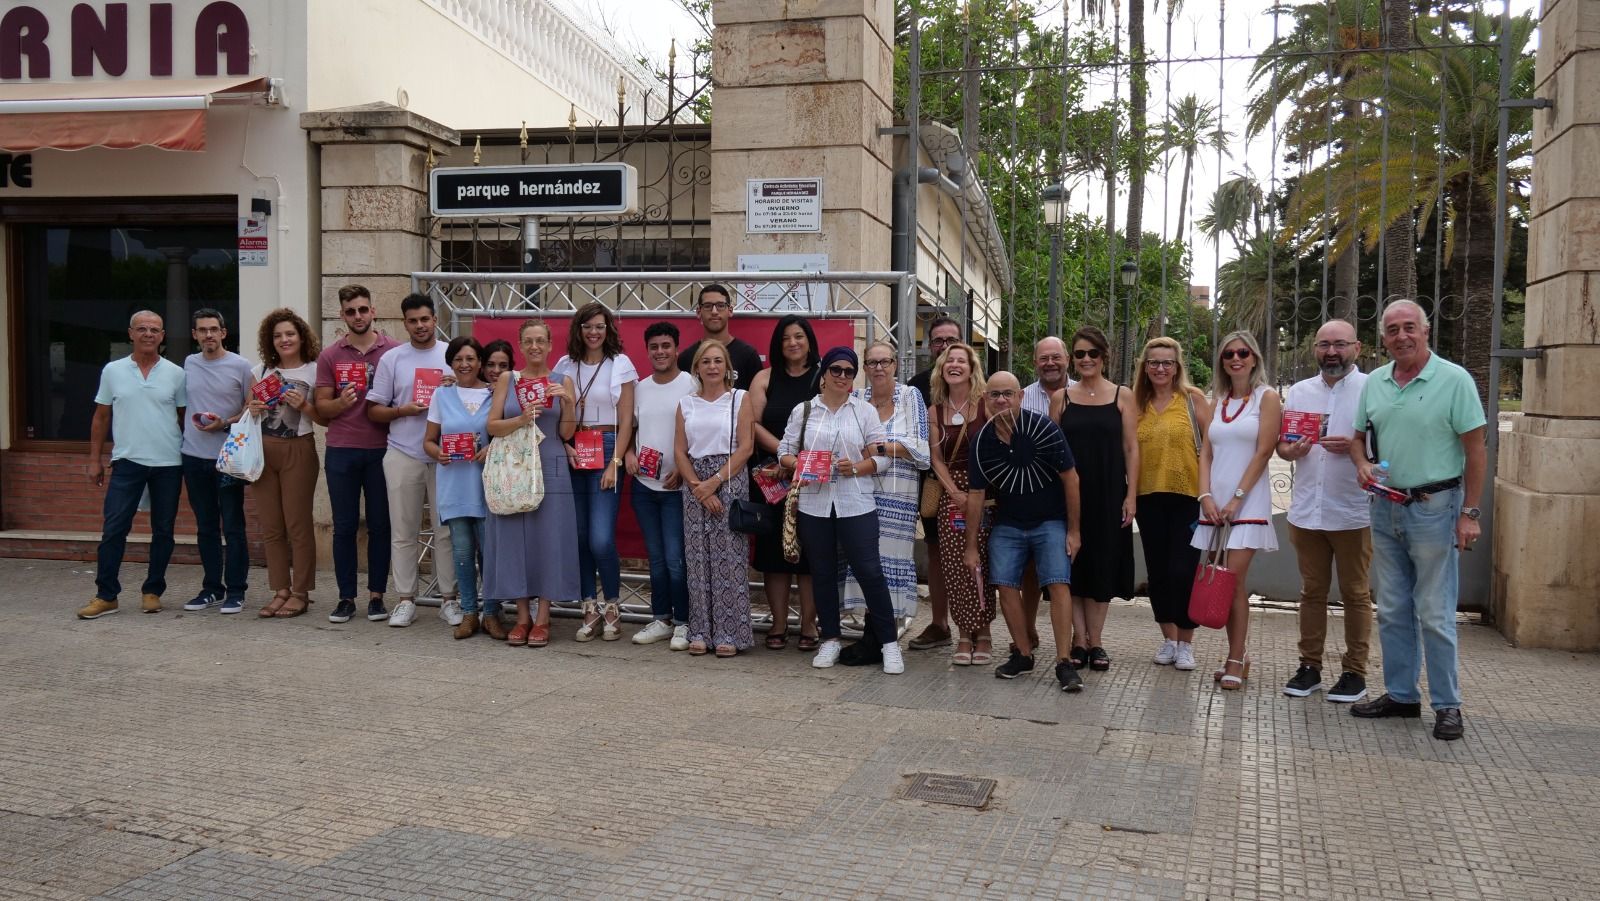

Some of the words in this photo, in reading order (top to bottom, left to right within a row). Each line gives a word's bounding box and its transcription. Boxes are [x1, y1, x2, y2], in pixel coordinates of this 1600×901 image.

[0, 1, 249, 79] RNIA
[457, 184, 510, 200] parque
[519, 179, 601, 196] hernández
